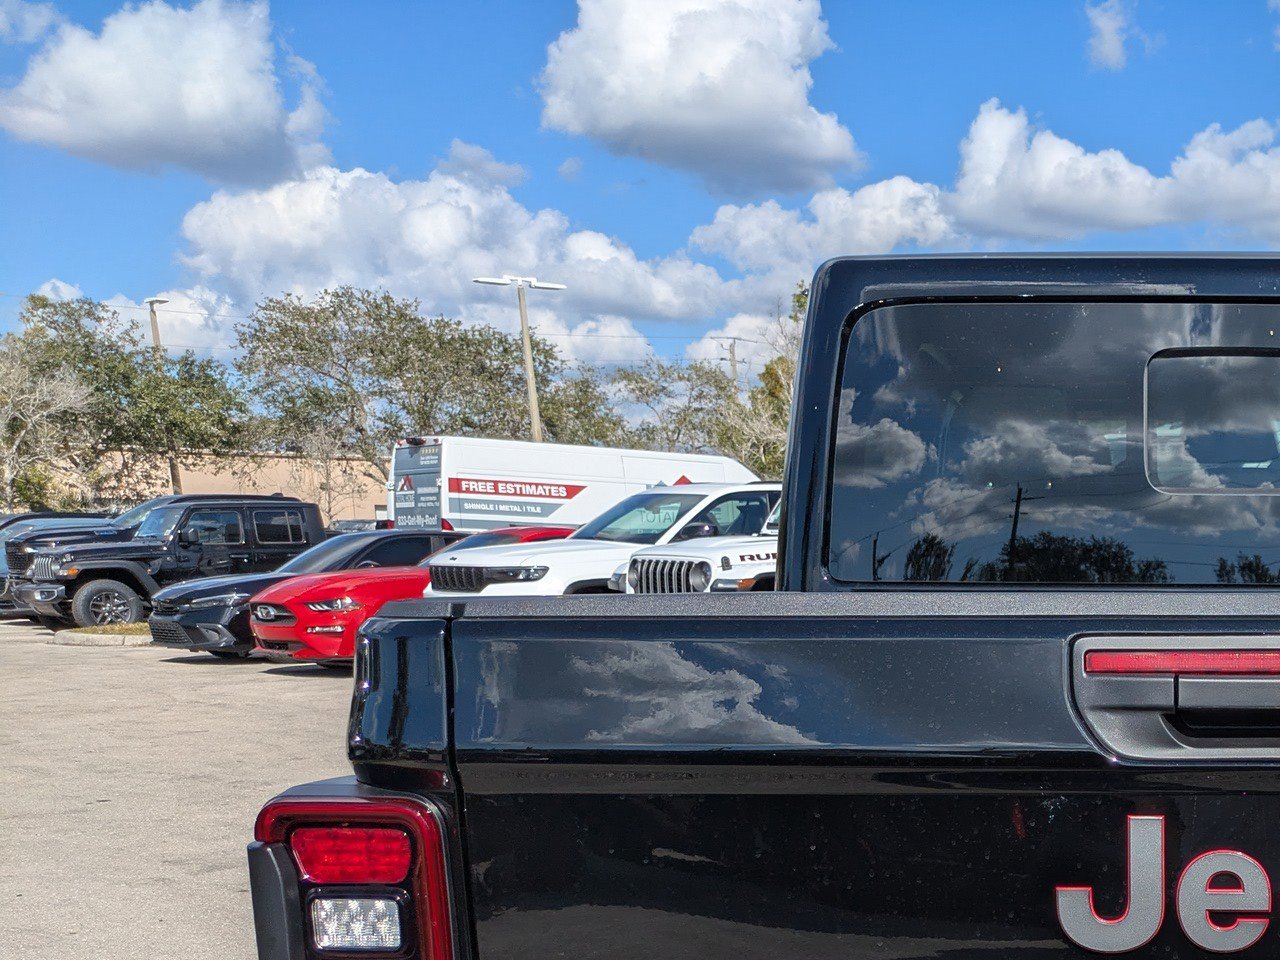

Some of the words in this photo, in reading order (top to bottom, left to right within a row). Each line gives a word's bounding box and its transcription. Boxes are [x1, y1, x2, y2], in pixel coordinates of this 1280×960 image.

[461, 481, 496, 493] FREE
[498, 483, 568, 497] ESTIMATES
[464, 502, 494, 511] SHINGLE
[499, 504, 522, 512] METAL
[739, 552, 778, 562] RU
